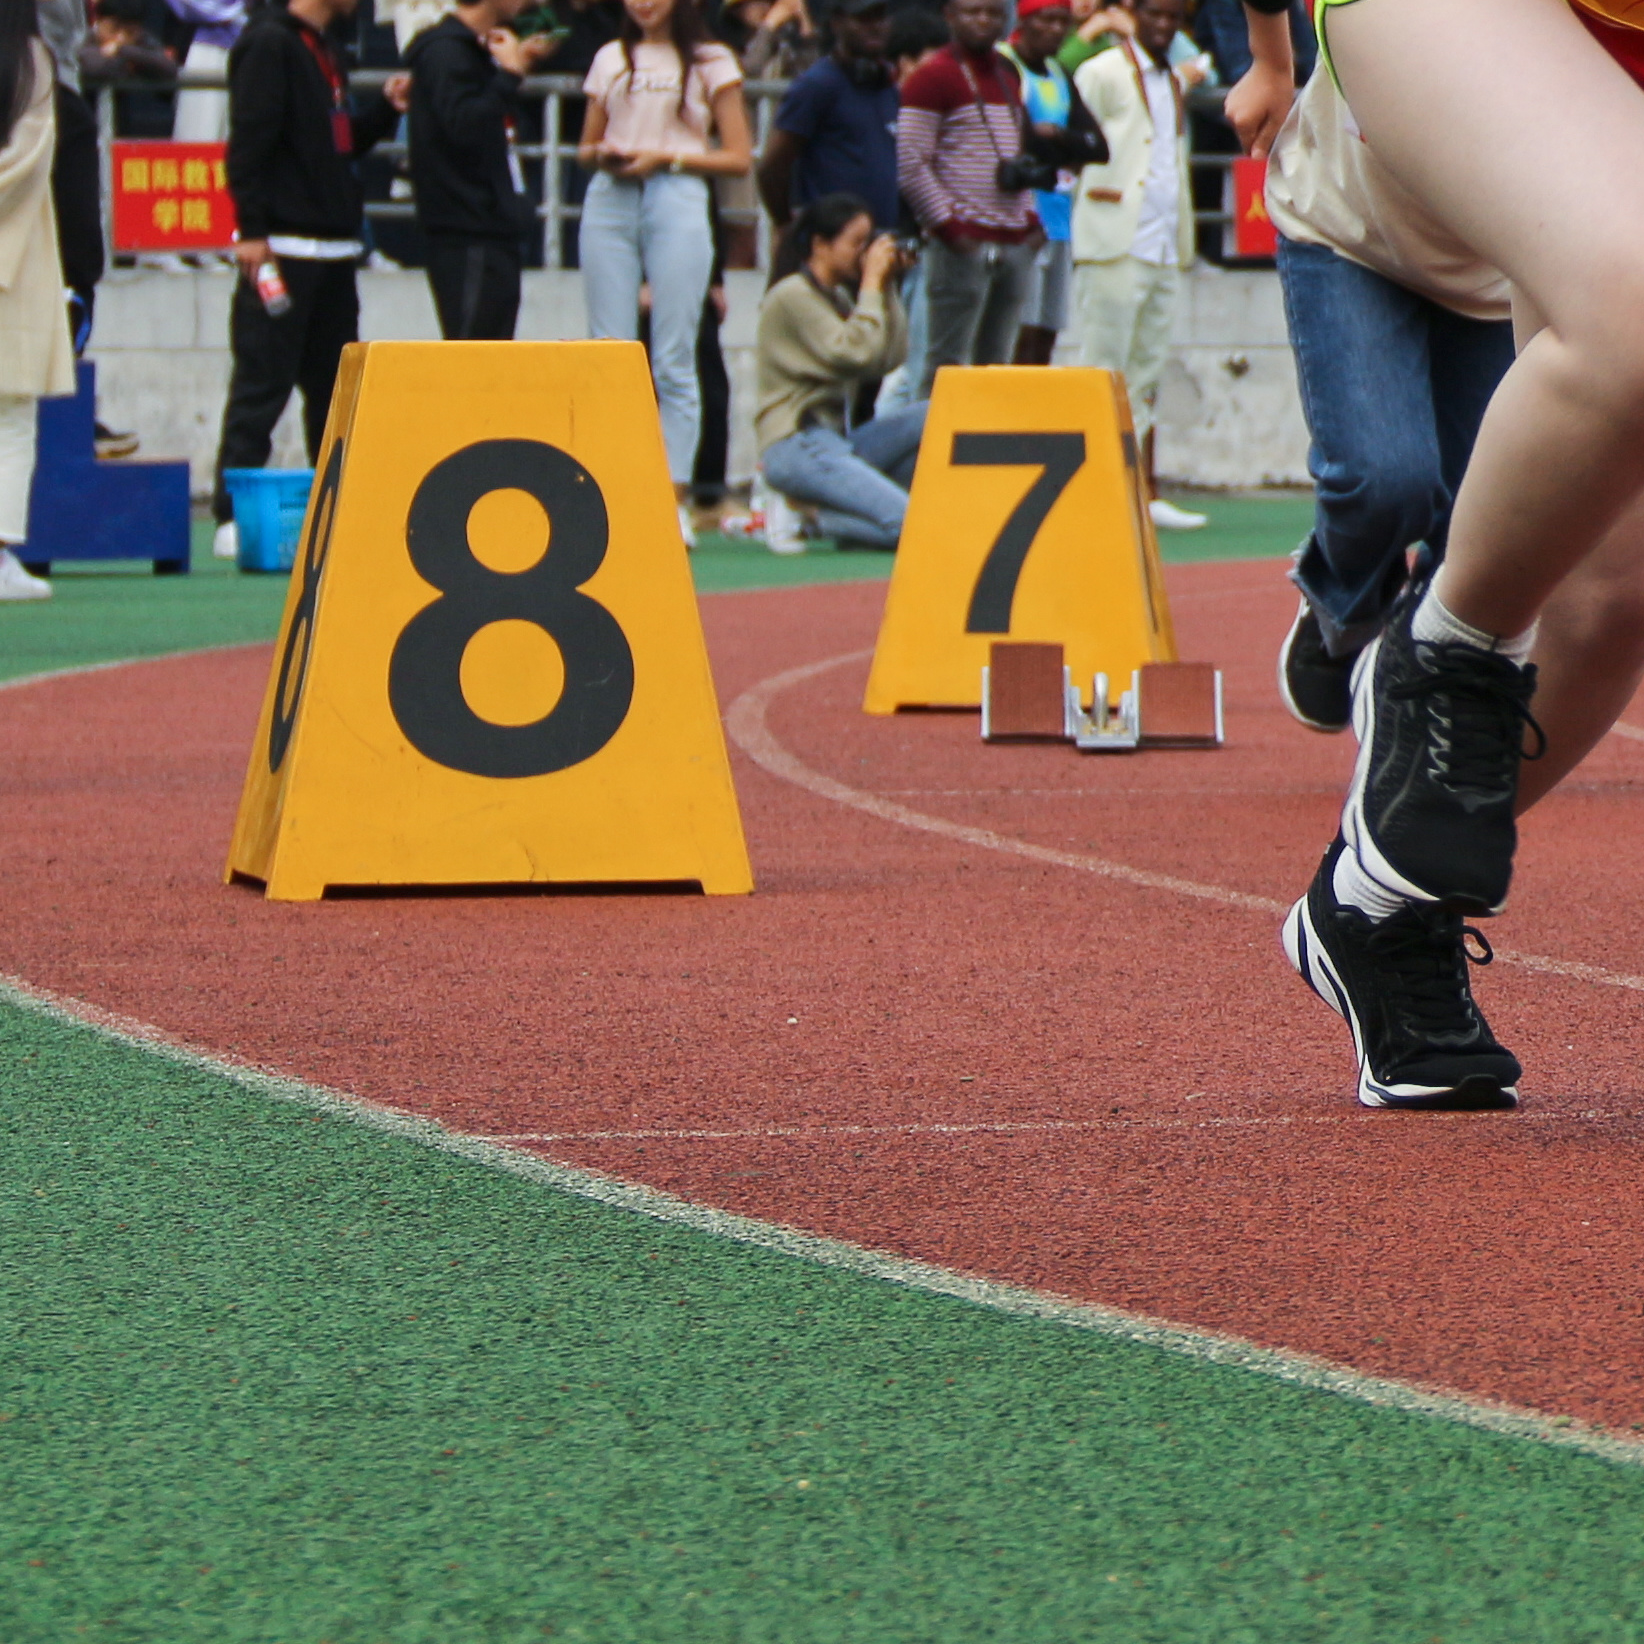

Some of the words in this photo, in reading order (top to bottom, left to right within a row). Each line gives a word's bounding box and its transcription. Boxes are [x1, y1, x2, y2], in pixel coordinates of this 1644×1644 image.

[152, 198, 211, 233] 学院
[387, 437, 635, 779] 8
[949, 431, 1087, 634] 7
